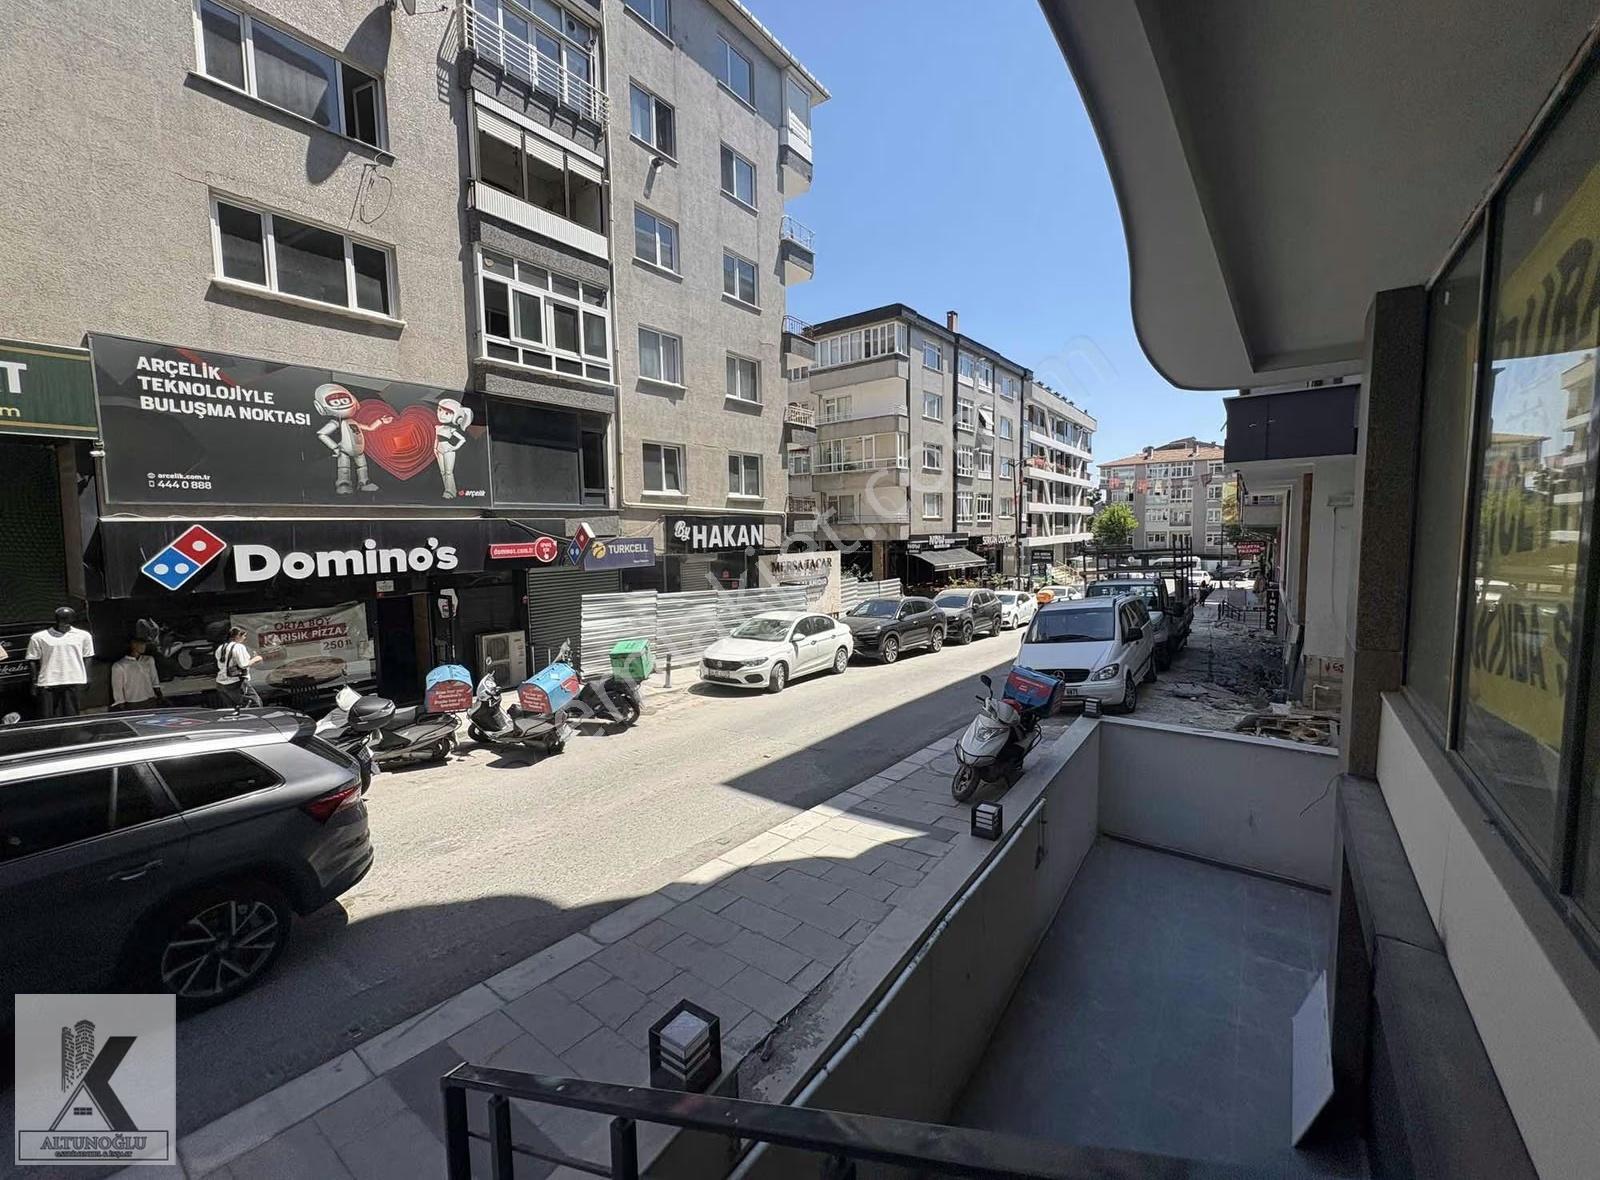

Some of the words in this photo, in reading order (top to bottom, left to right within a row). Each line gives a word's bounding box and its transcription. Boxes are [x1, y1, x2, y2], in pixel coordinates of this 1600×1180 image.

[136, 356, 222, 380] ARÇELİK
[137, 375, 275, 405] TEKNOLOJİYLE
[140, 395, 237, 419] BULUŞMA
[239, 406, 311, 426] NOKTASI
[157, 472, 211, 481] arcelik.com.tr
[157, 480, 180, 489] 444
[181, 480, 189, 489] 0
[191, 480, 212, 490] 888
[674, 520, 691, 542] By
[692, 524, 764, 549] HAKAN
[608, 543, 649, 555] TURKCELL
[232, 536, 459, 584] Domino's
[274, 621, 305, 630] ORTA
[309, 617, 332, 626] BOY
[312, 626, 343, 638] PİZZA
